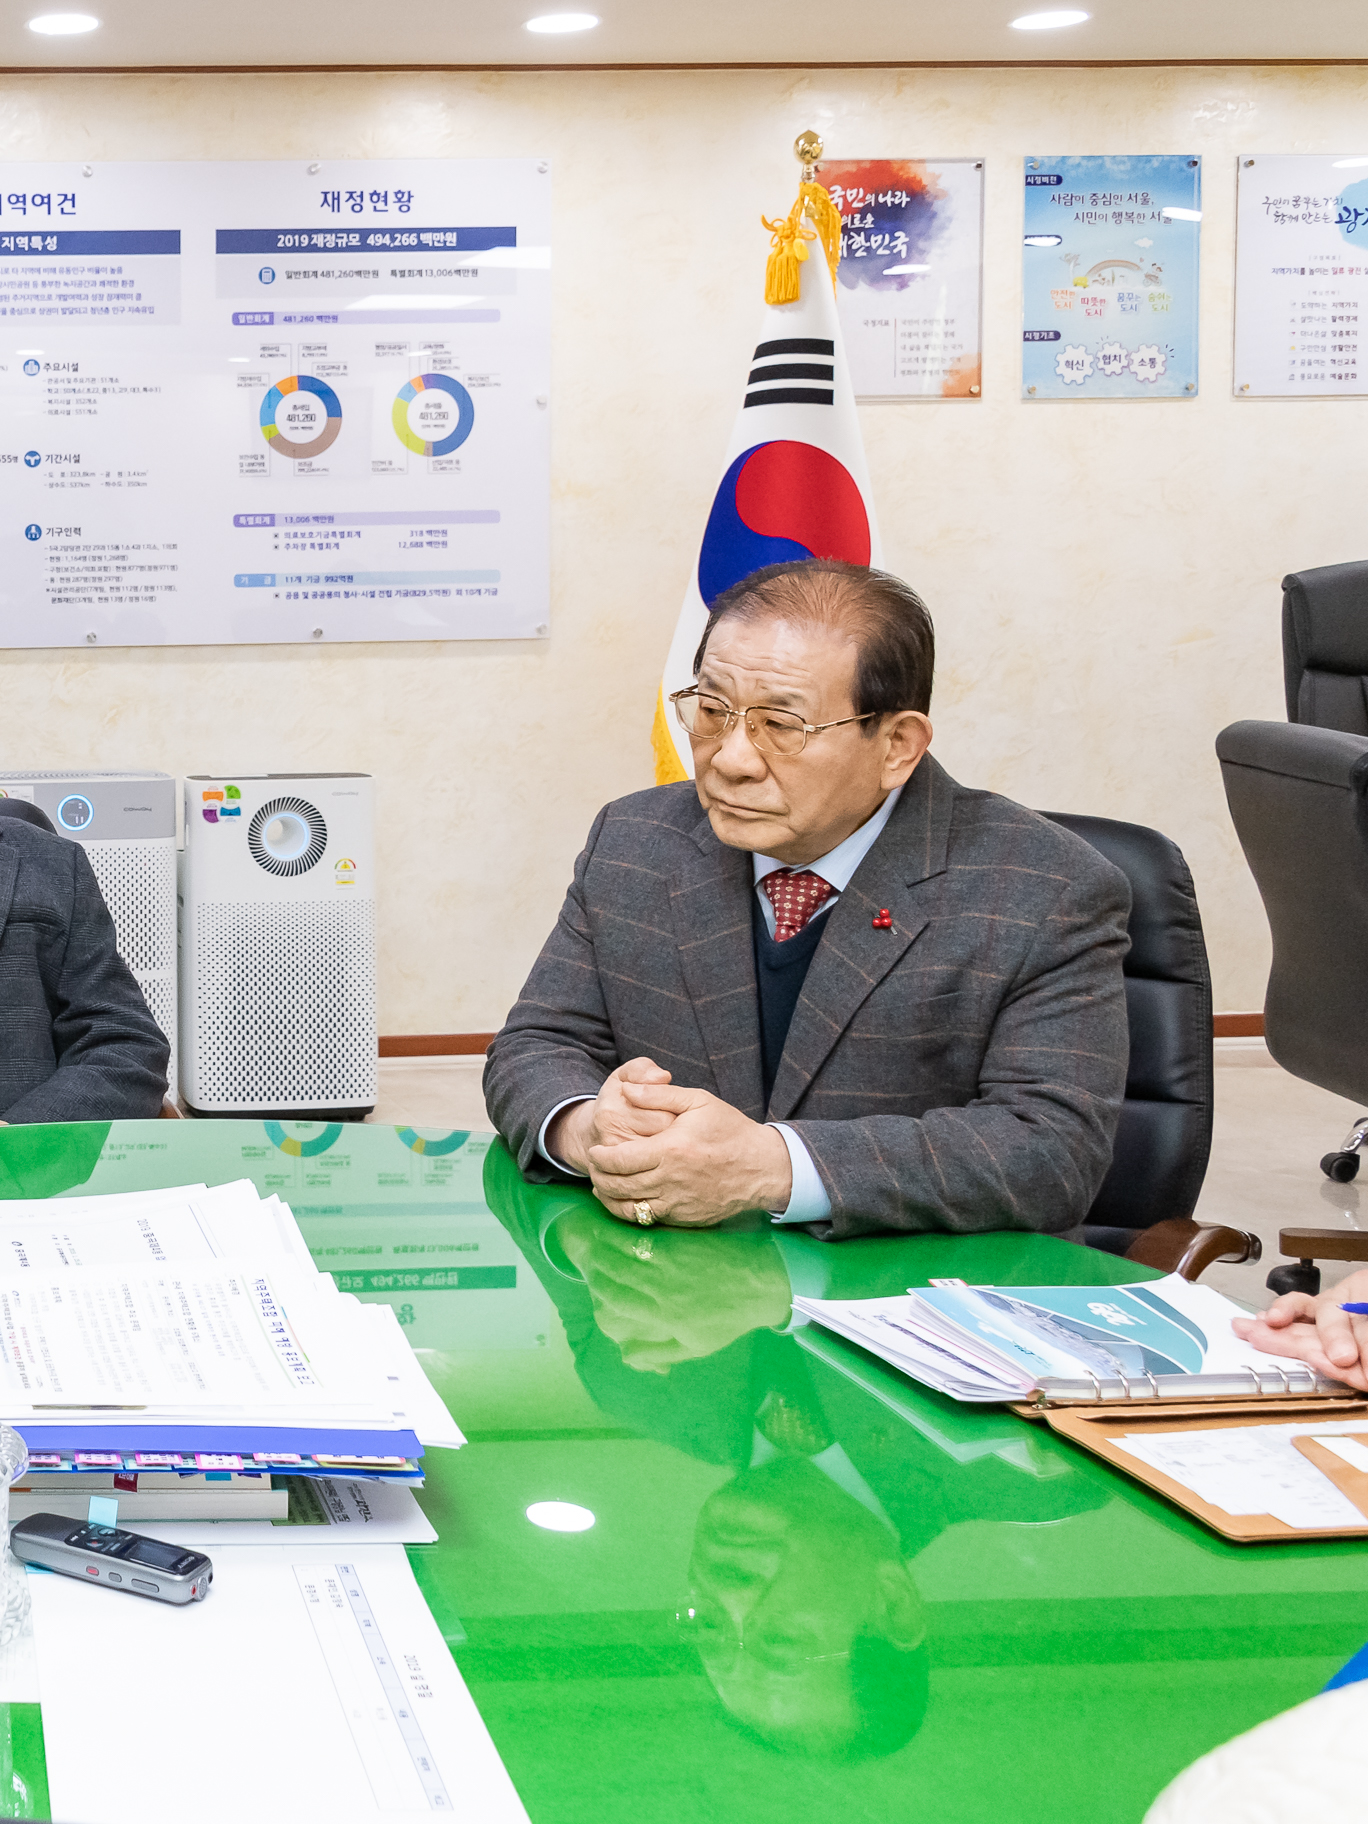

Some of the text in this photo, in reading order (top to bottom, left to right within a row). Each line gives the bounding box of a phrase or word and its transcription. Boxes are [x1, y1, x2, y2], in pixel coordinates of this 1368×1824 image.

[320, 189, 414, 214] 재정현황
[829, 185, 910, 211] 국민의 나라
[1050, 192, 1154, 206] 사람이 중심인 서울,
[1262, 196, 1289, 215] 구민이
[1292, 195, 1322, 210] 꿈꾸는
[841, 212, 875, 229] 의로운
[1074, 211, 1108, 225] 시민이
[1111, 211, 1145, 225] 행복한
[1273, 211, 1333, 225] 함께 만드는
[1, 235, 58, 251] 지역특성
[277, 232, 457, 248] 2019 재정규모 494,266 백만원
[59, 266, 85, 275] 유동인구
[285, 268, 479, 280] 일반회계 481,260백만원 특별회계 13,006백만원
[1348, 267, 1361, 275] 광진
[1050, 290, 1075, 300] 안전한
[1117, 292, 1141, 303] 꿈꾸는
[1148, 292, 1172, 302] 숨쉬는
[1054, 301, 1072, 310] 도시
[1080, 296, 1106, 306] 따뜻한
[1085, 308, 1102, 317] 도시
[1120, 303, 1138, 312] 도시
[1152, 303, 1169, 312] 도시
[1102, 353, 1122, 365] 협치
[1138, 357, 1157, 367] 소통
[43, 362, 79, 373] 주요시설
[1065, 359, 1084, 371] 혁신
[45, 453, 80, 464] 기간시설
[45, 527, 82, 537] 기구인력
